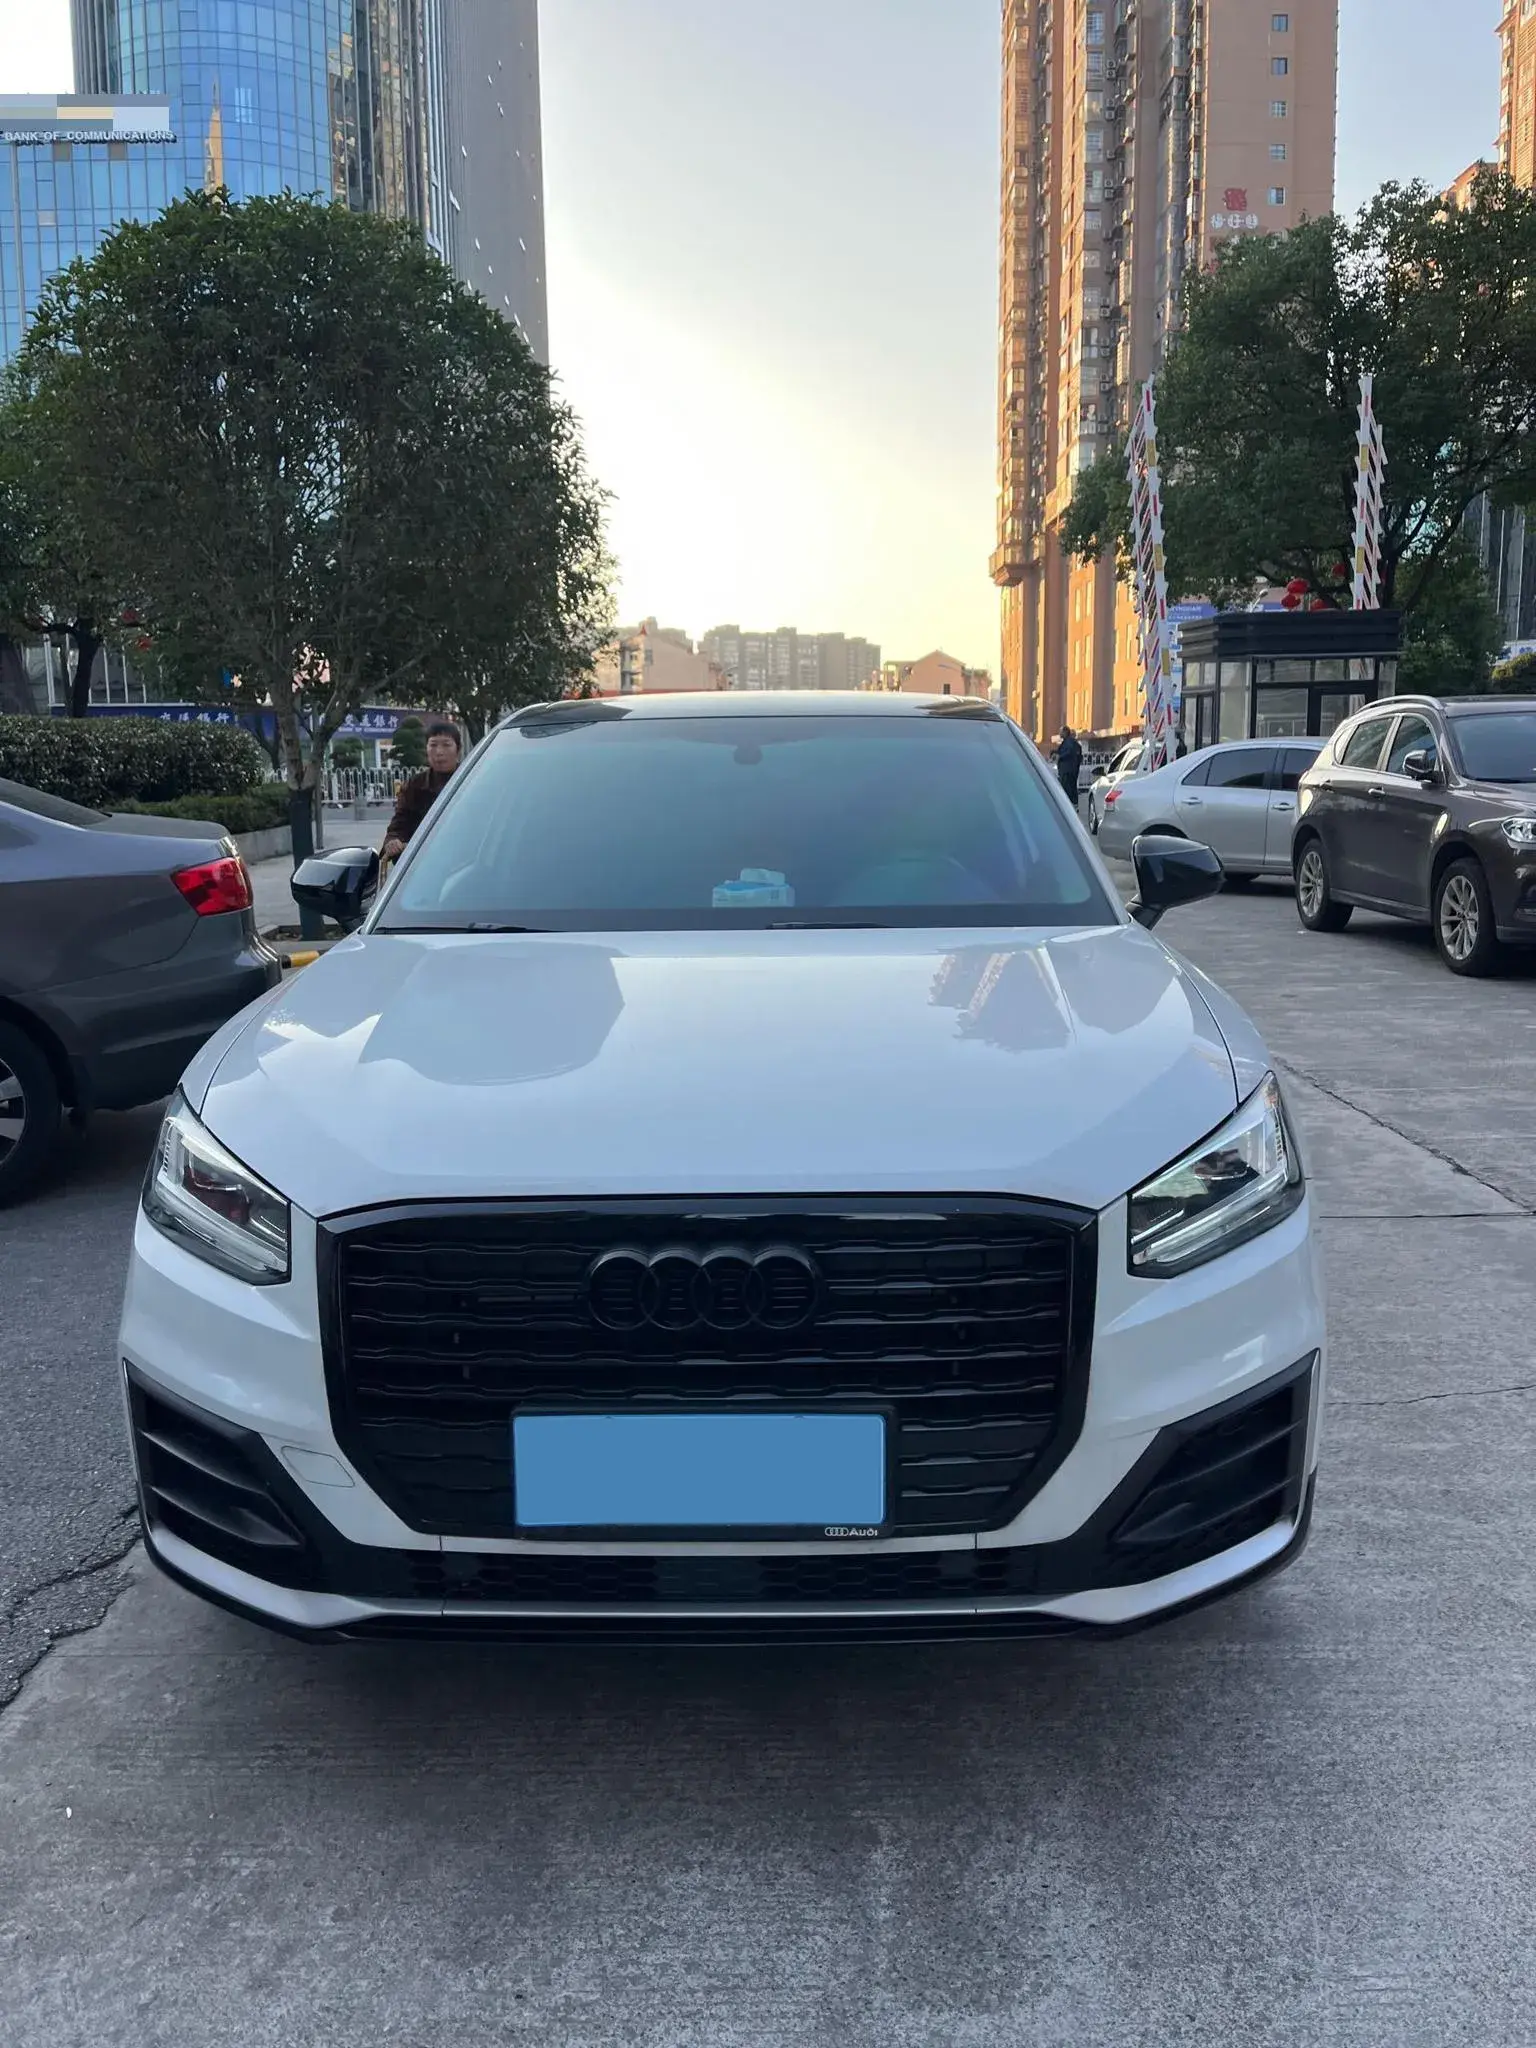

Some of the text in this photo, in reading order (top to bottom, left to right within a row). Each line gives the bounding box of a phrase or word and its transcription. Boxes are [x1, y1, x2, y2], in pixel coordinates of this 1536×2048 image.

[4, 130, 175, 141] BANK OF COMMUNICATIONS
[849, 1527, 878, 1536] Audi
